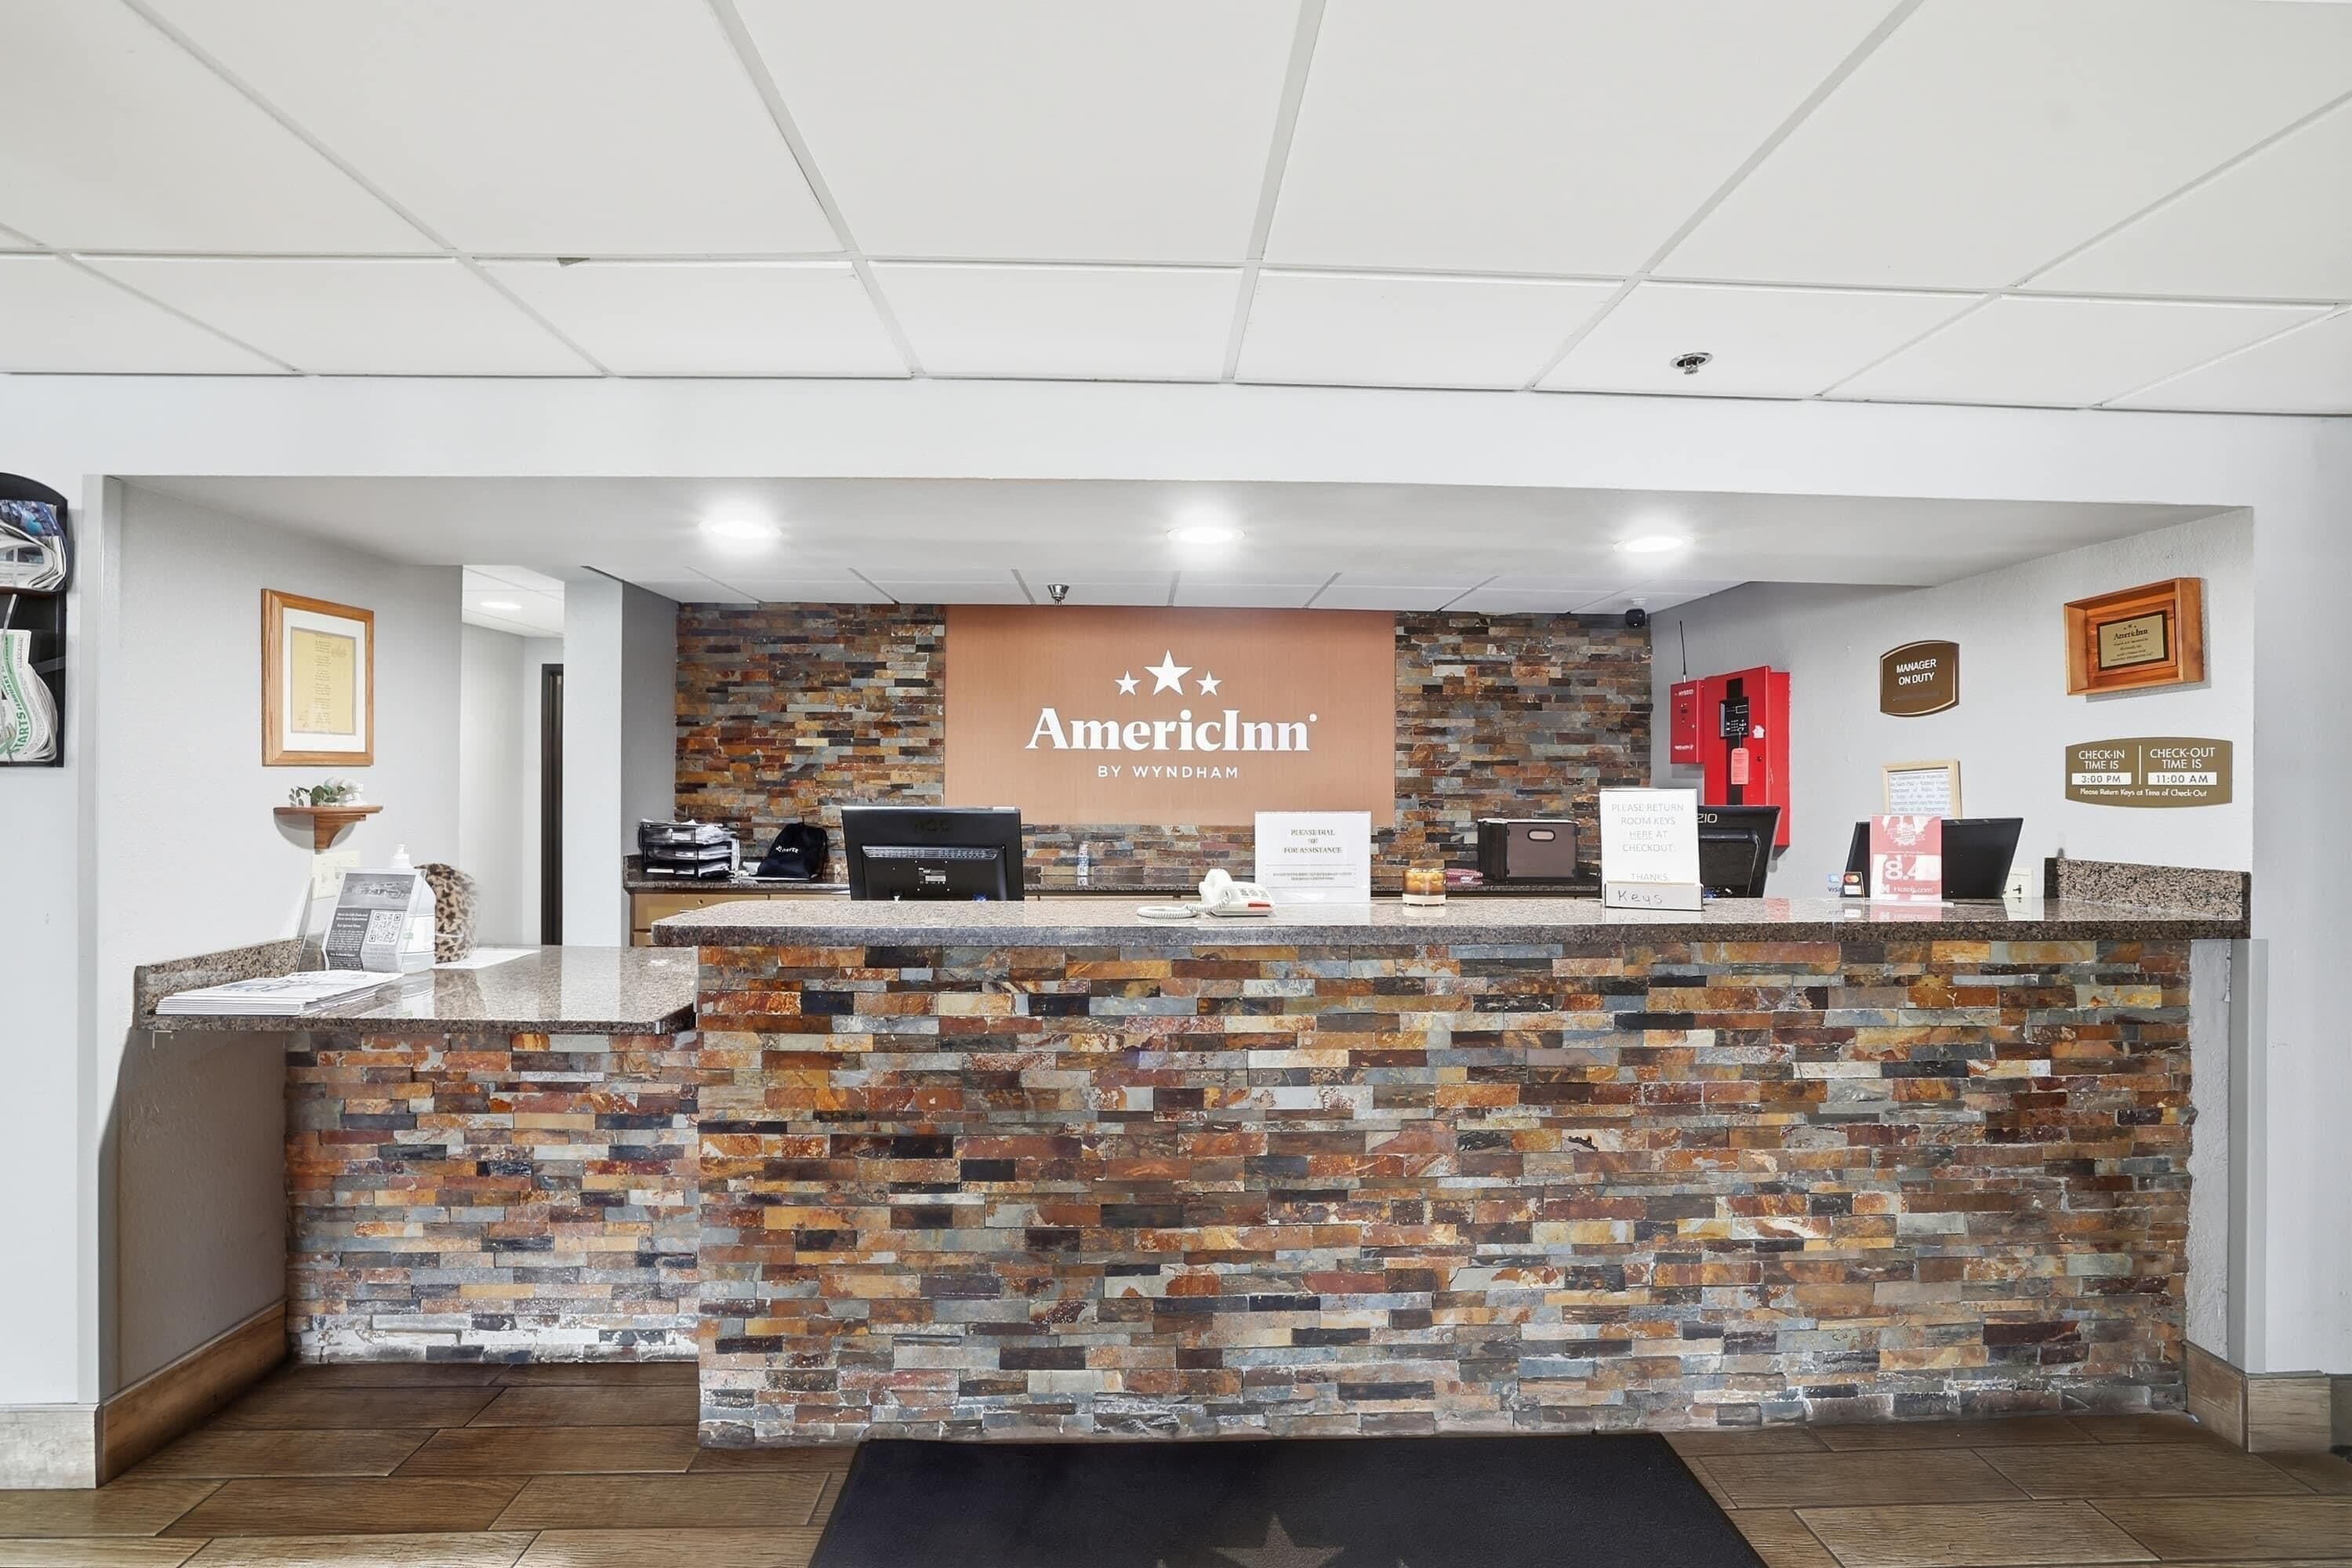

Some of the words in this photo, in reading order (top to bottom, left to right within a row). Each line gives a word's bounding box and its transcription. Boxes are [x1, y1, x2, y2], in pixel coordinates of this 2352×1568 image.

[1896, 659, 1936, 673] MANAGER
[1898, 675, 1911, 685] ON
[1912, 672, 1935, 684] DUTY
[1025, 708, 1310, 751] AmericInn
[2078, 750, 2125, 760] CHECK-IN
[2150, 747, 2216, 758] CHECK-OUT
[2084, 760, 2106, 770] TIME
[2111, 760, 2118, 770] IS
[2161, 759, 2187, 769] TIME
[2192, 759, 2202, 768] IS
[1098, 766, 1121, 778] BY
[1133, 766, 1239, 779] WYNDHAM
[2157, 775, 2185, 783] 11:00
[2189, 775, 2209, 783] AM
[2120, 789, 2135, 797] Keys
[1612, 803, 1644, 811] PLEASE
[1647, 803, 1684, 811] RETURN
[1697, 813, 1718, 823] ZIO
[1630, 830, 1653, 839] HERE
[1617, 890, 1663, 906] Keys
